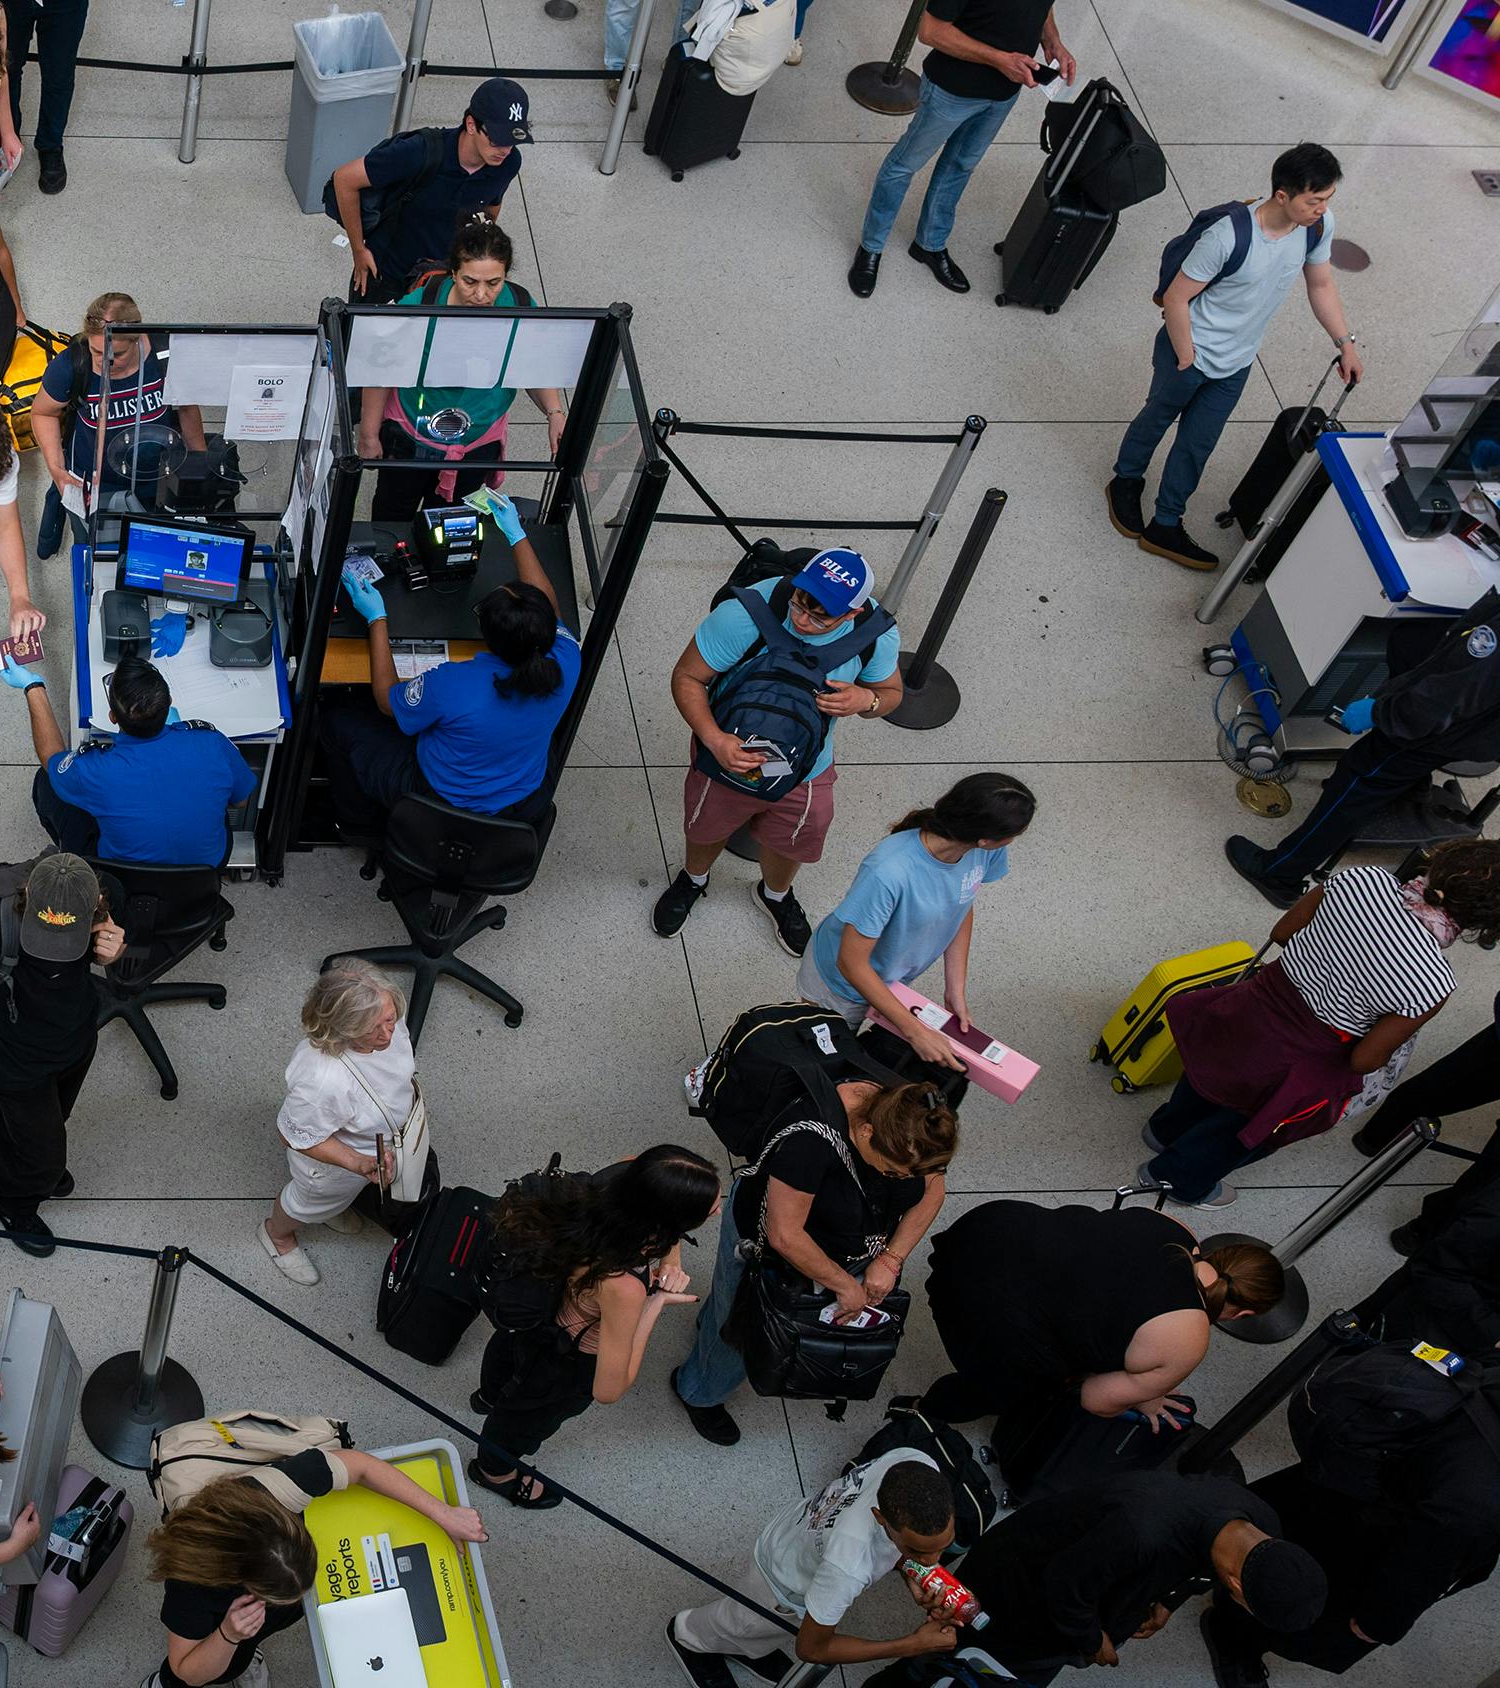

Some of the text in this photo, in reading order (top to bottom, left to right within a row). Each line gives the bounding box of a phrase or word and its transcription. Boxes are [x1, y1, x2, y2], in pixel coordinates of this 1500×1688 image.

[509, 103, 522, 121] NY
[257, 378, 284, 386] BOLO
[819, 557, 859, 588] BILLS
[338, 1537, 361, 1596] reports
[438, 1557, 456, 1612] ramp.com/you
[943, 1584, 968, 1609] Arizo
